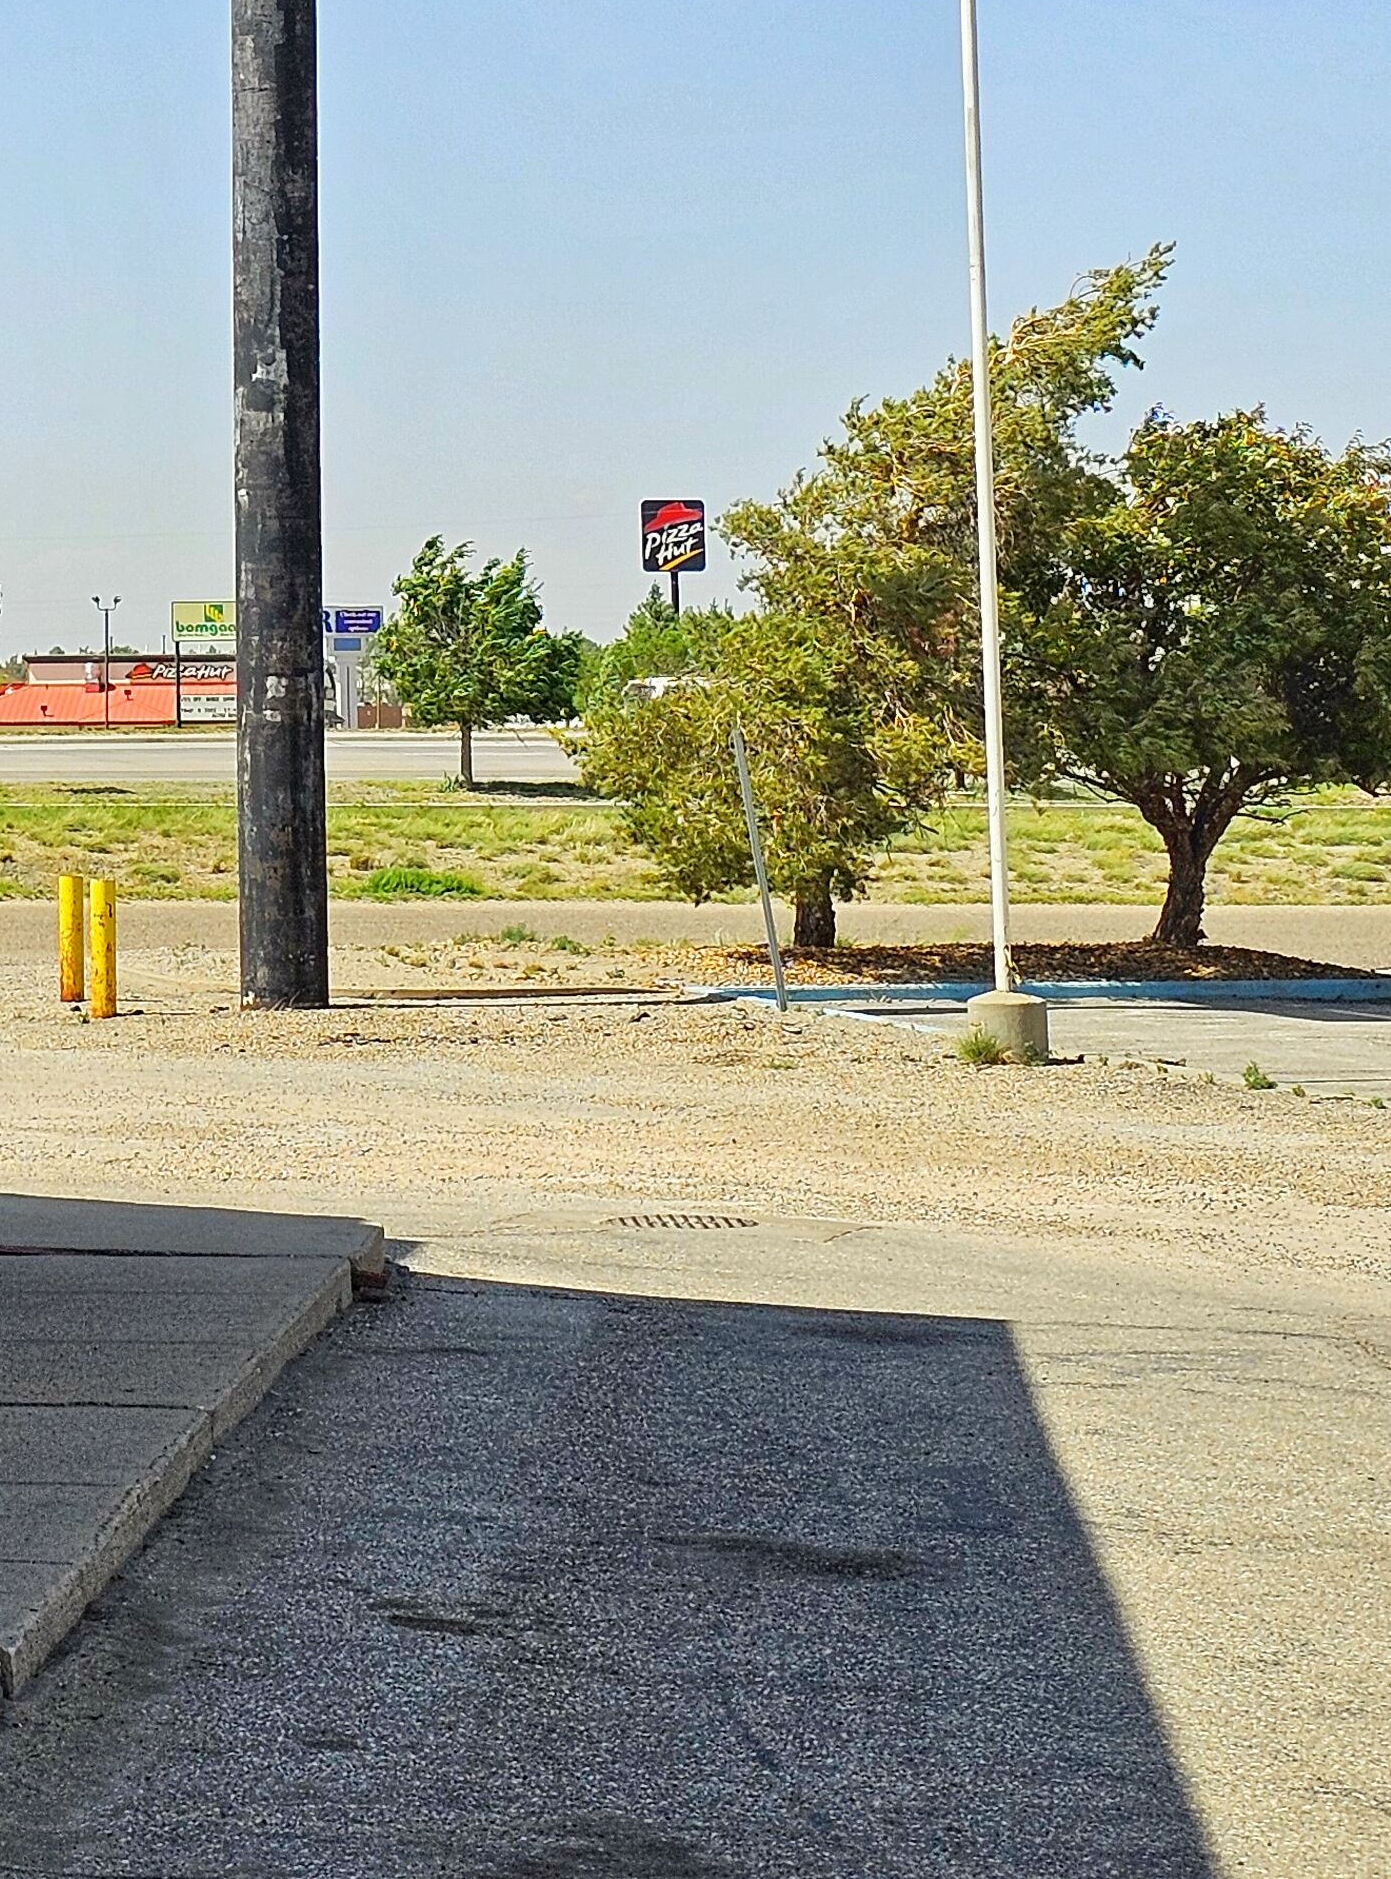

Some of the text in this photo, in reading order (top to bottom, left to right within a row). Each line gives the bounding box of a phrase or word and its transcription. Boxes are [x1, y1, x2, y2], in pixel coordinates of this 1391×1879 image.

[644, 522, 703, 560] Pizza
[655, 537, 699, 566] Hut
[196, 664, 233, 679] Hut
